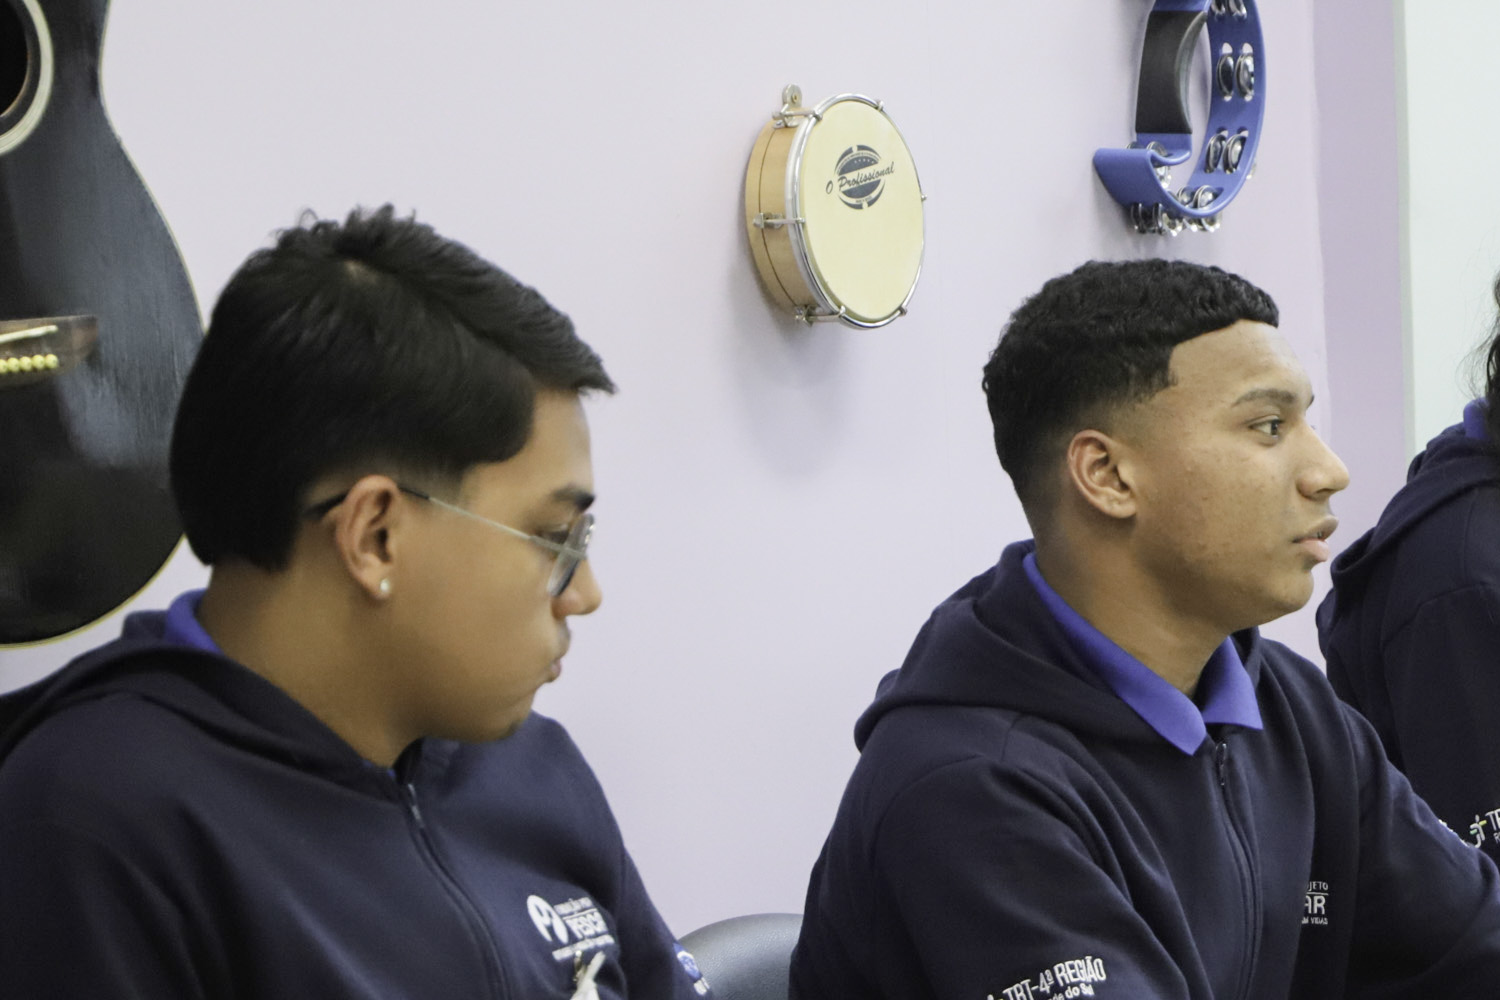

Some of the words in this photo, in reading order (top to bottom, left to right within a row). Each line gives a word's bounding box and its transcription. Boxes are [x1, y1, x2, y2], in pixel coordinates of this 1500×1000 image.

[825, 180, 834, 195] O
[837, 160, 895, 192] Profissional
[1053, 956, 1106, 987] REGIÃO
[1065, 985, 1081, 999] do
